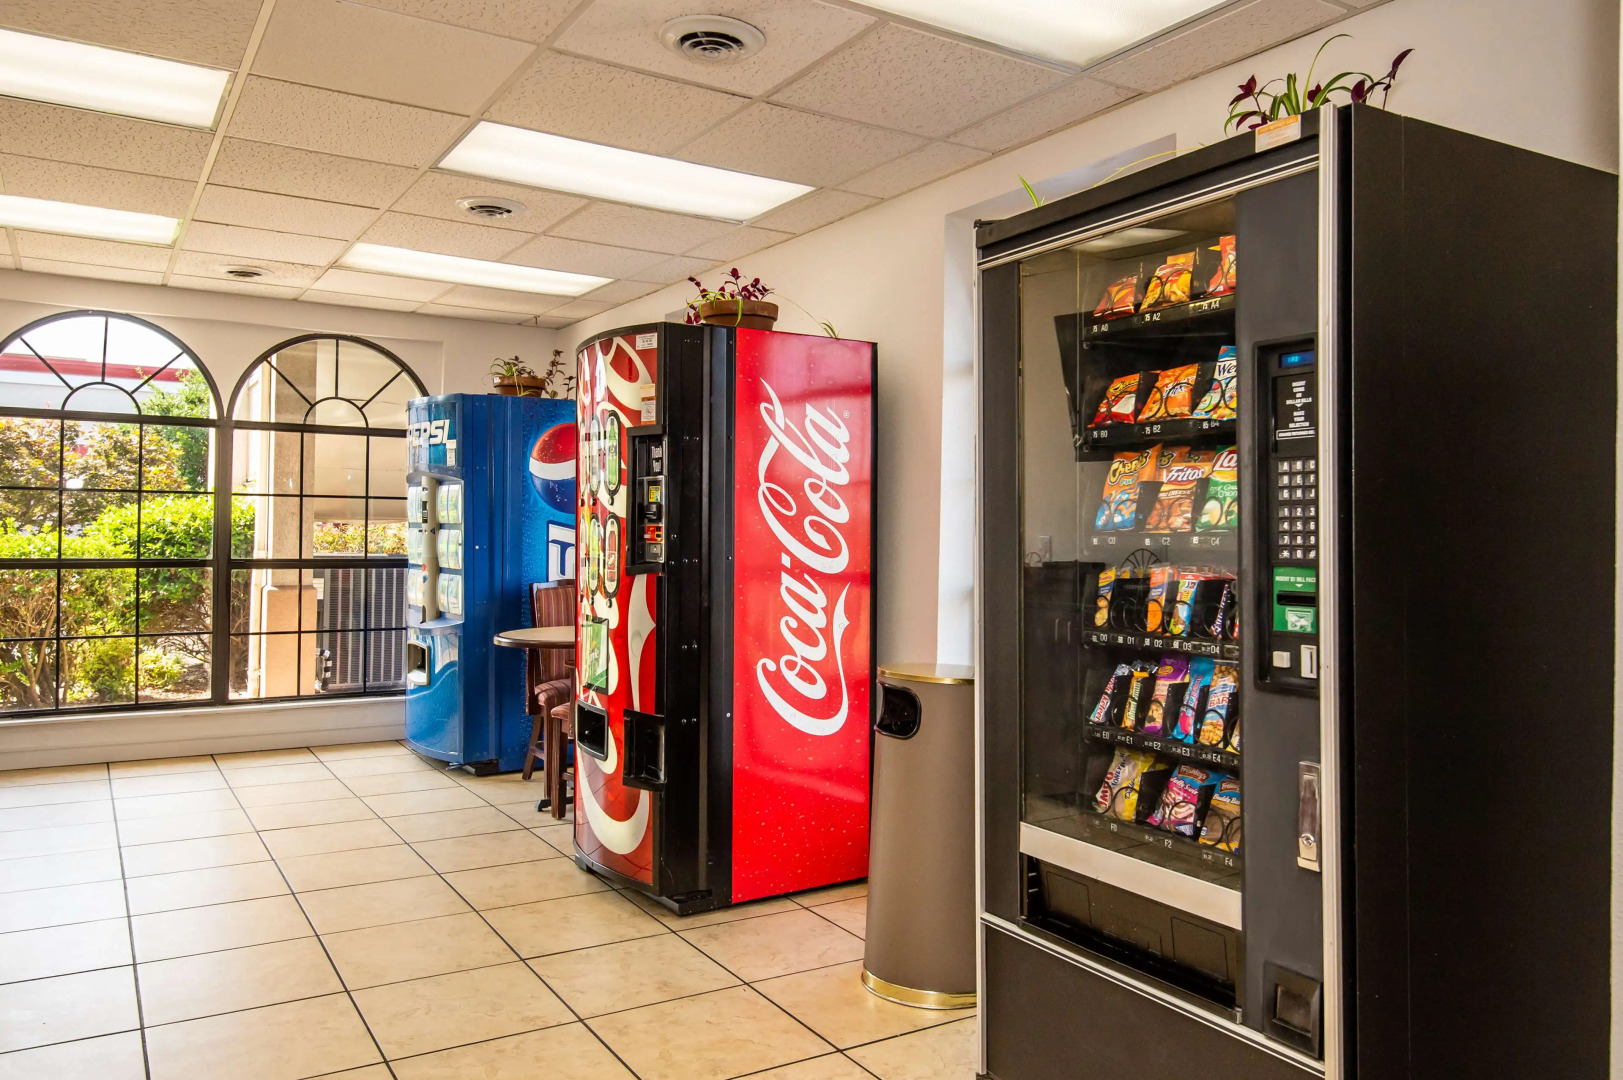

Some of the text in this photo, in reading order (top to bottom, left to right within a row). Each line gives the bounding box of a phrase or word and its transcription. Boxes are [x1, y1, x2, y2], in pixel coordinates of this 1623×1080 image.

[1210, 300, 1220, 310] A4
[1152, 312, 1160, 322] A2
[1100, 323, 1108, 332] A0
[409, 419, 450, 446] PEPSI
[1152, 424, 1161, 433] B2
[1100, 430, 1108, 438] B0
[1213, 451, 1238, 471] La
[1283, 462, 1288, 471] A
[1164, 466, 1204, 483] Fritos
[1297, 475, 1301, 483] E
[1310, 474, 1314, 483] F
[1310, 489, 1314, 497] J
[1108, 536, 1116, 545] C0
[1162, 537, 1170, 546] C2
[1210, 537, 1220, 546] C4
[1310, 536, 1314, 544] 9
[757, 376, 850, 736] Coca-Cola
[1102, 731, 1110, 740] E0
[1126, 736, 1133, 744] E1
[1154, 741, 1161, 750] E2
[1182, 747, 1190, 756] E3
[1212, 753, 1221, 762] E4
[1184, 784, 1198, 794] Swir
[1110, 823, 1118, 832] F0
[1164, 839, 1172, 849] F2
[1225, 857, 1233, 867] F4
